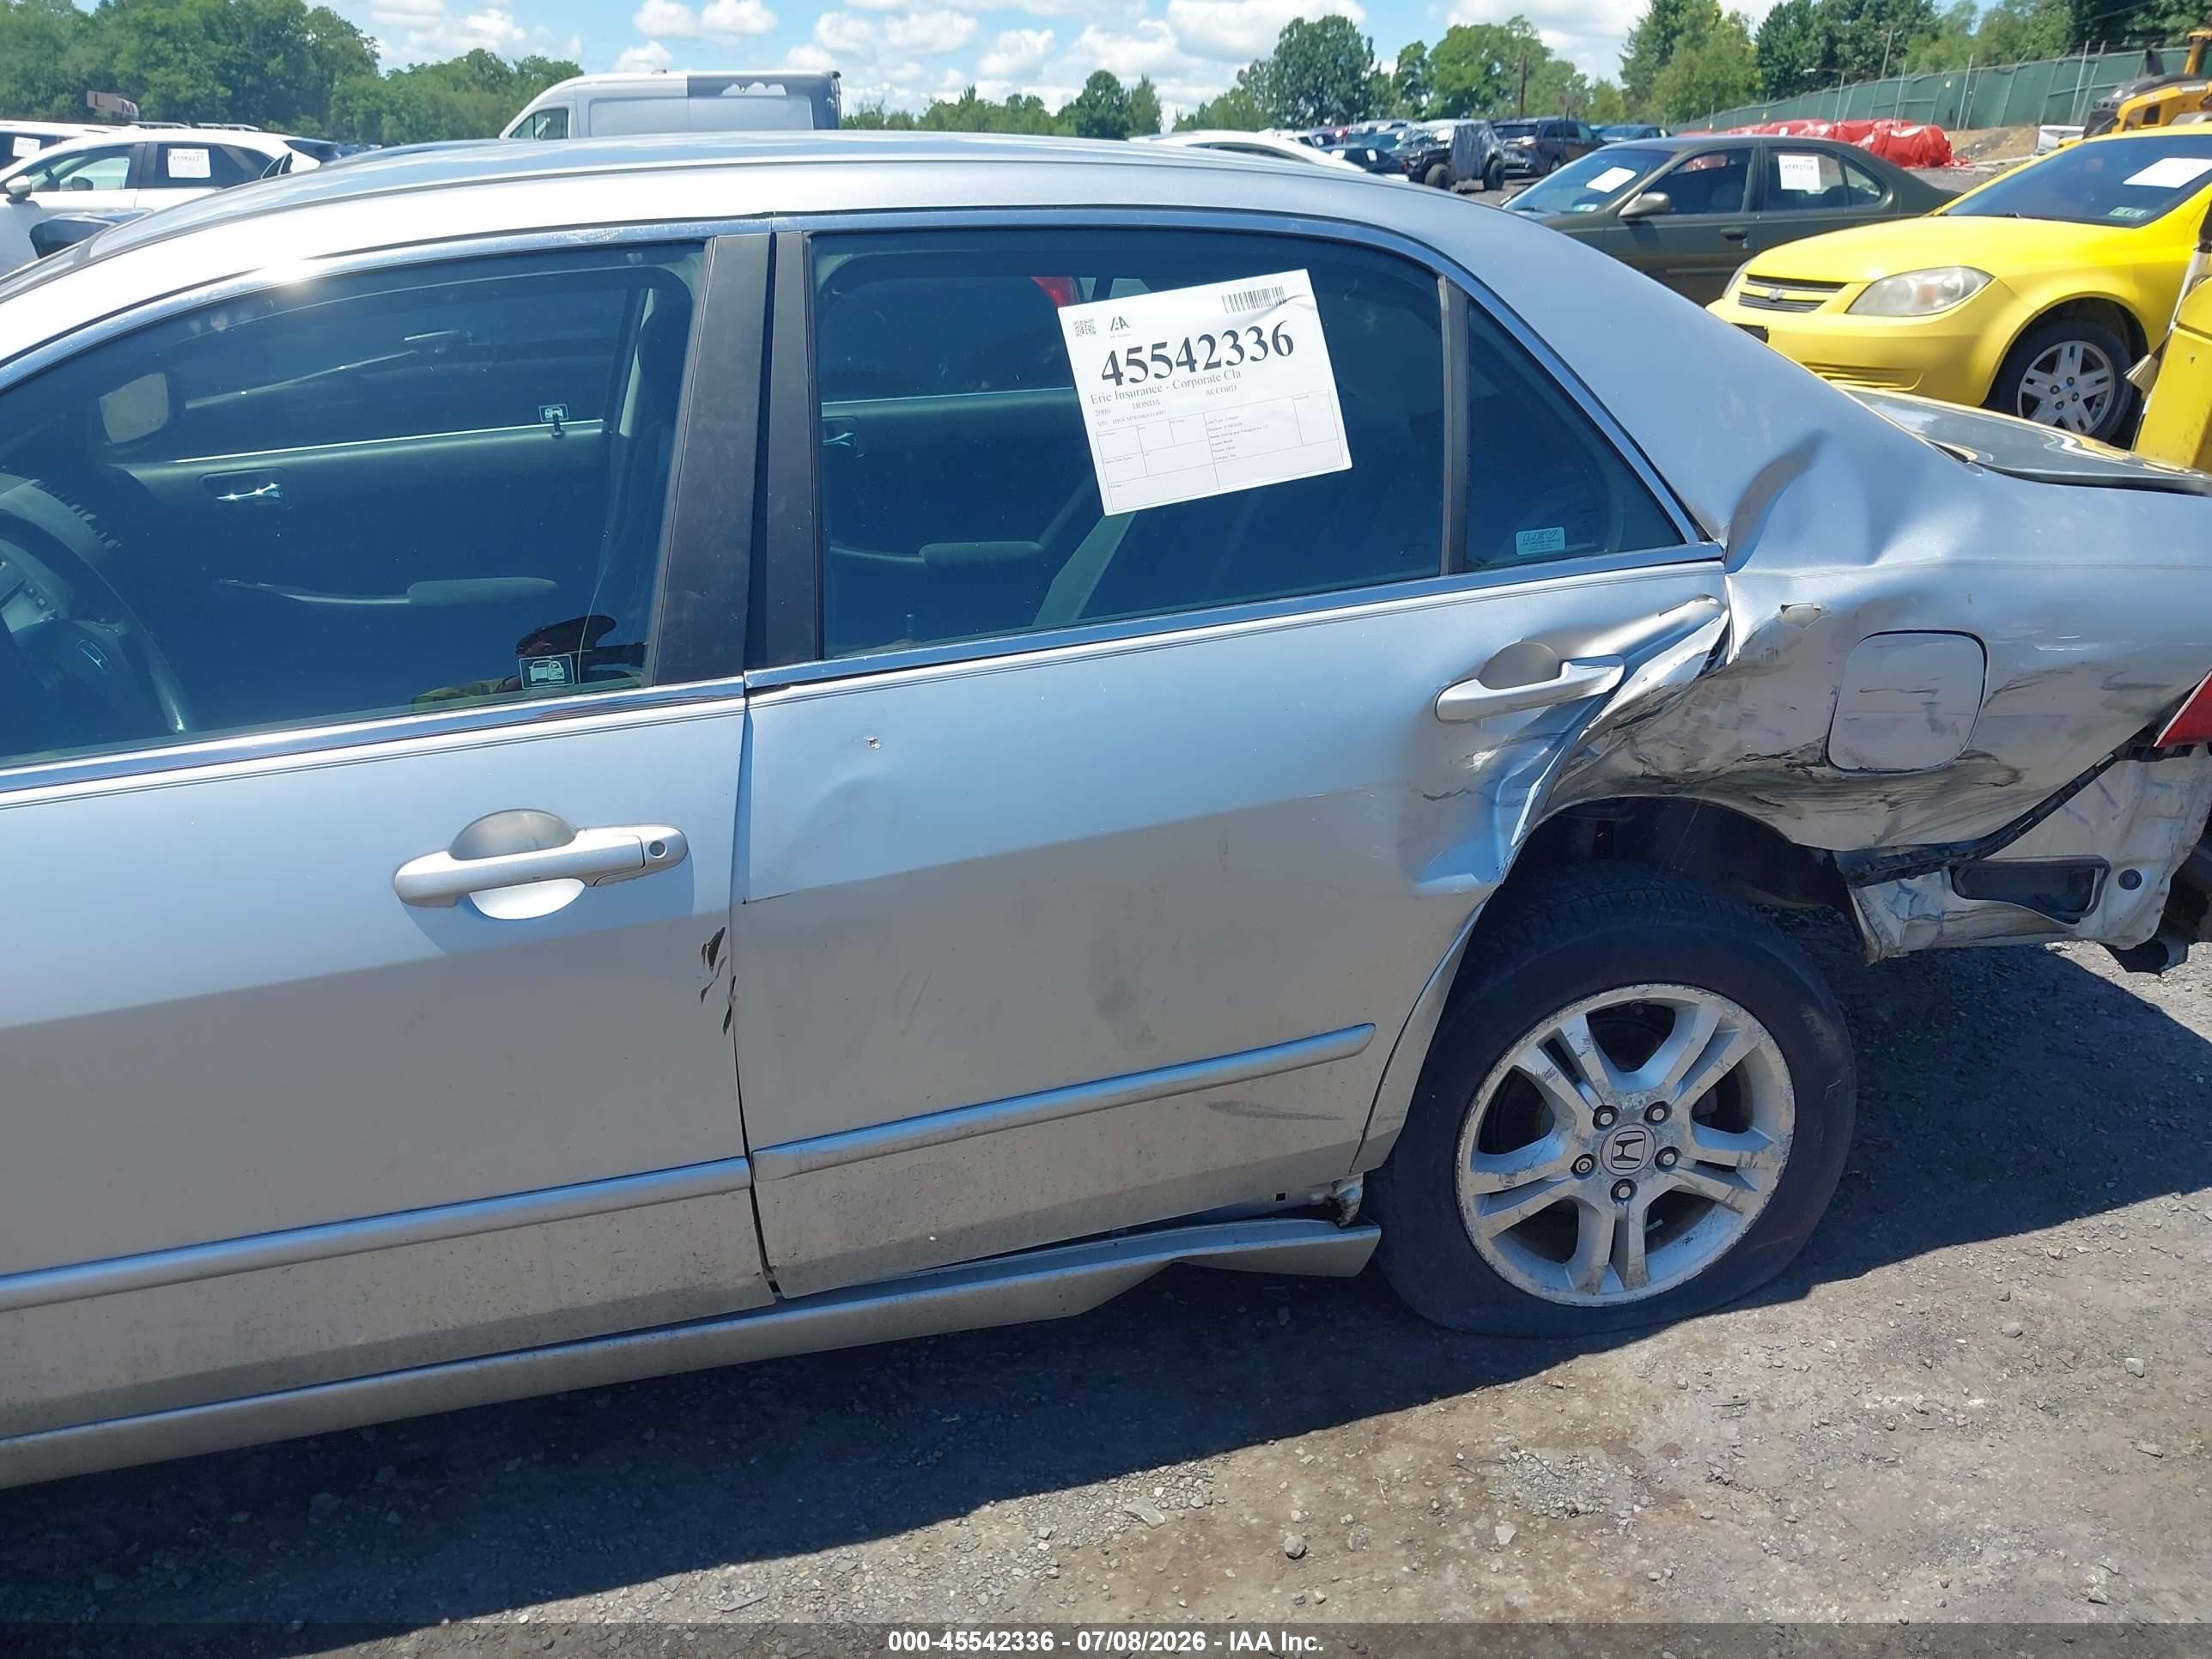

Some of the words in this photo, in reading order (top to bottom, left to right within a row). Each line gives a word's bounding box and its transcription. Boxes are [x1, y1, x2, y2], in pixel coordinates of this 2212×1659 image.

[1102, 319, 1293, 386] 45542336
[1115, 384, 1163, 400] Insurance
[1172, 373, 1222, 390] Corporate
[1224, 369, 1242, 380] Cla
[1206, 384, 1237, 397] ACCORD
[1132, 398, 1161, 410] HONDA
